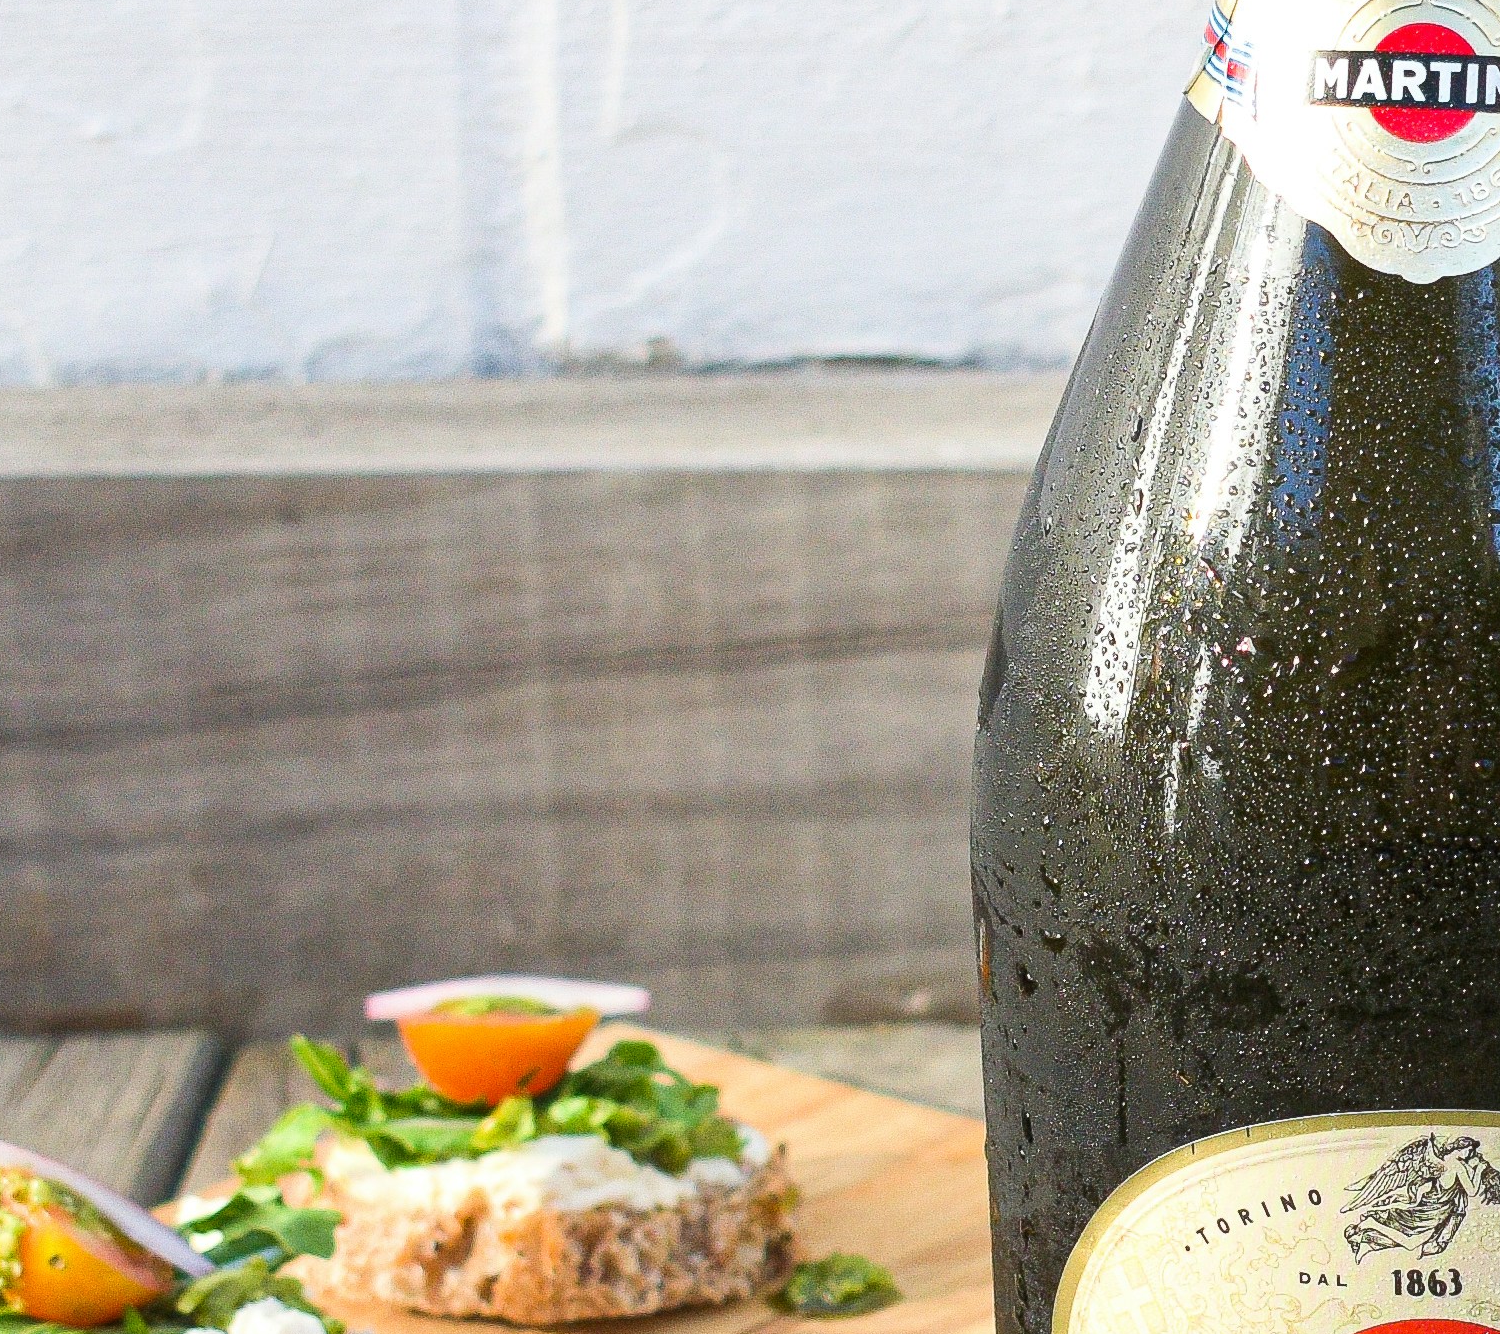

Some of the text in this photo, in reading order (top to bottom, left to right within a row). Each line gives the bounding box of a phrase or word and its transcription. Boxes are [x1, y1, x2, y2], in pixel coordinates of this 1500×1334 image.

[1195, 1188, 1323, 1245] TORINO
[1298, 1270, 1348, 1288] DAL
[1390, 1268, 1463, 1298] 1863
